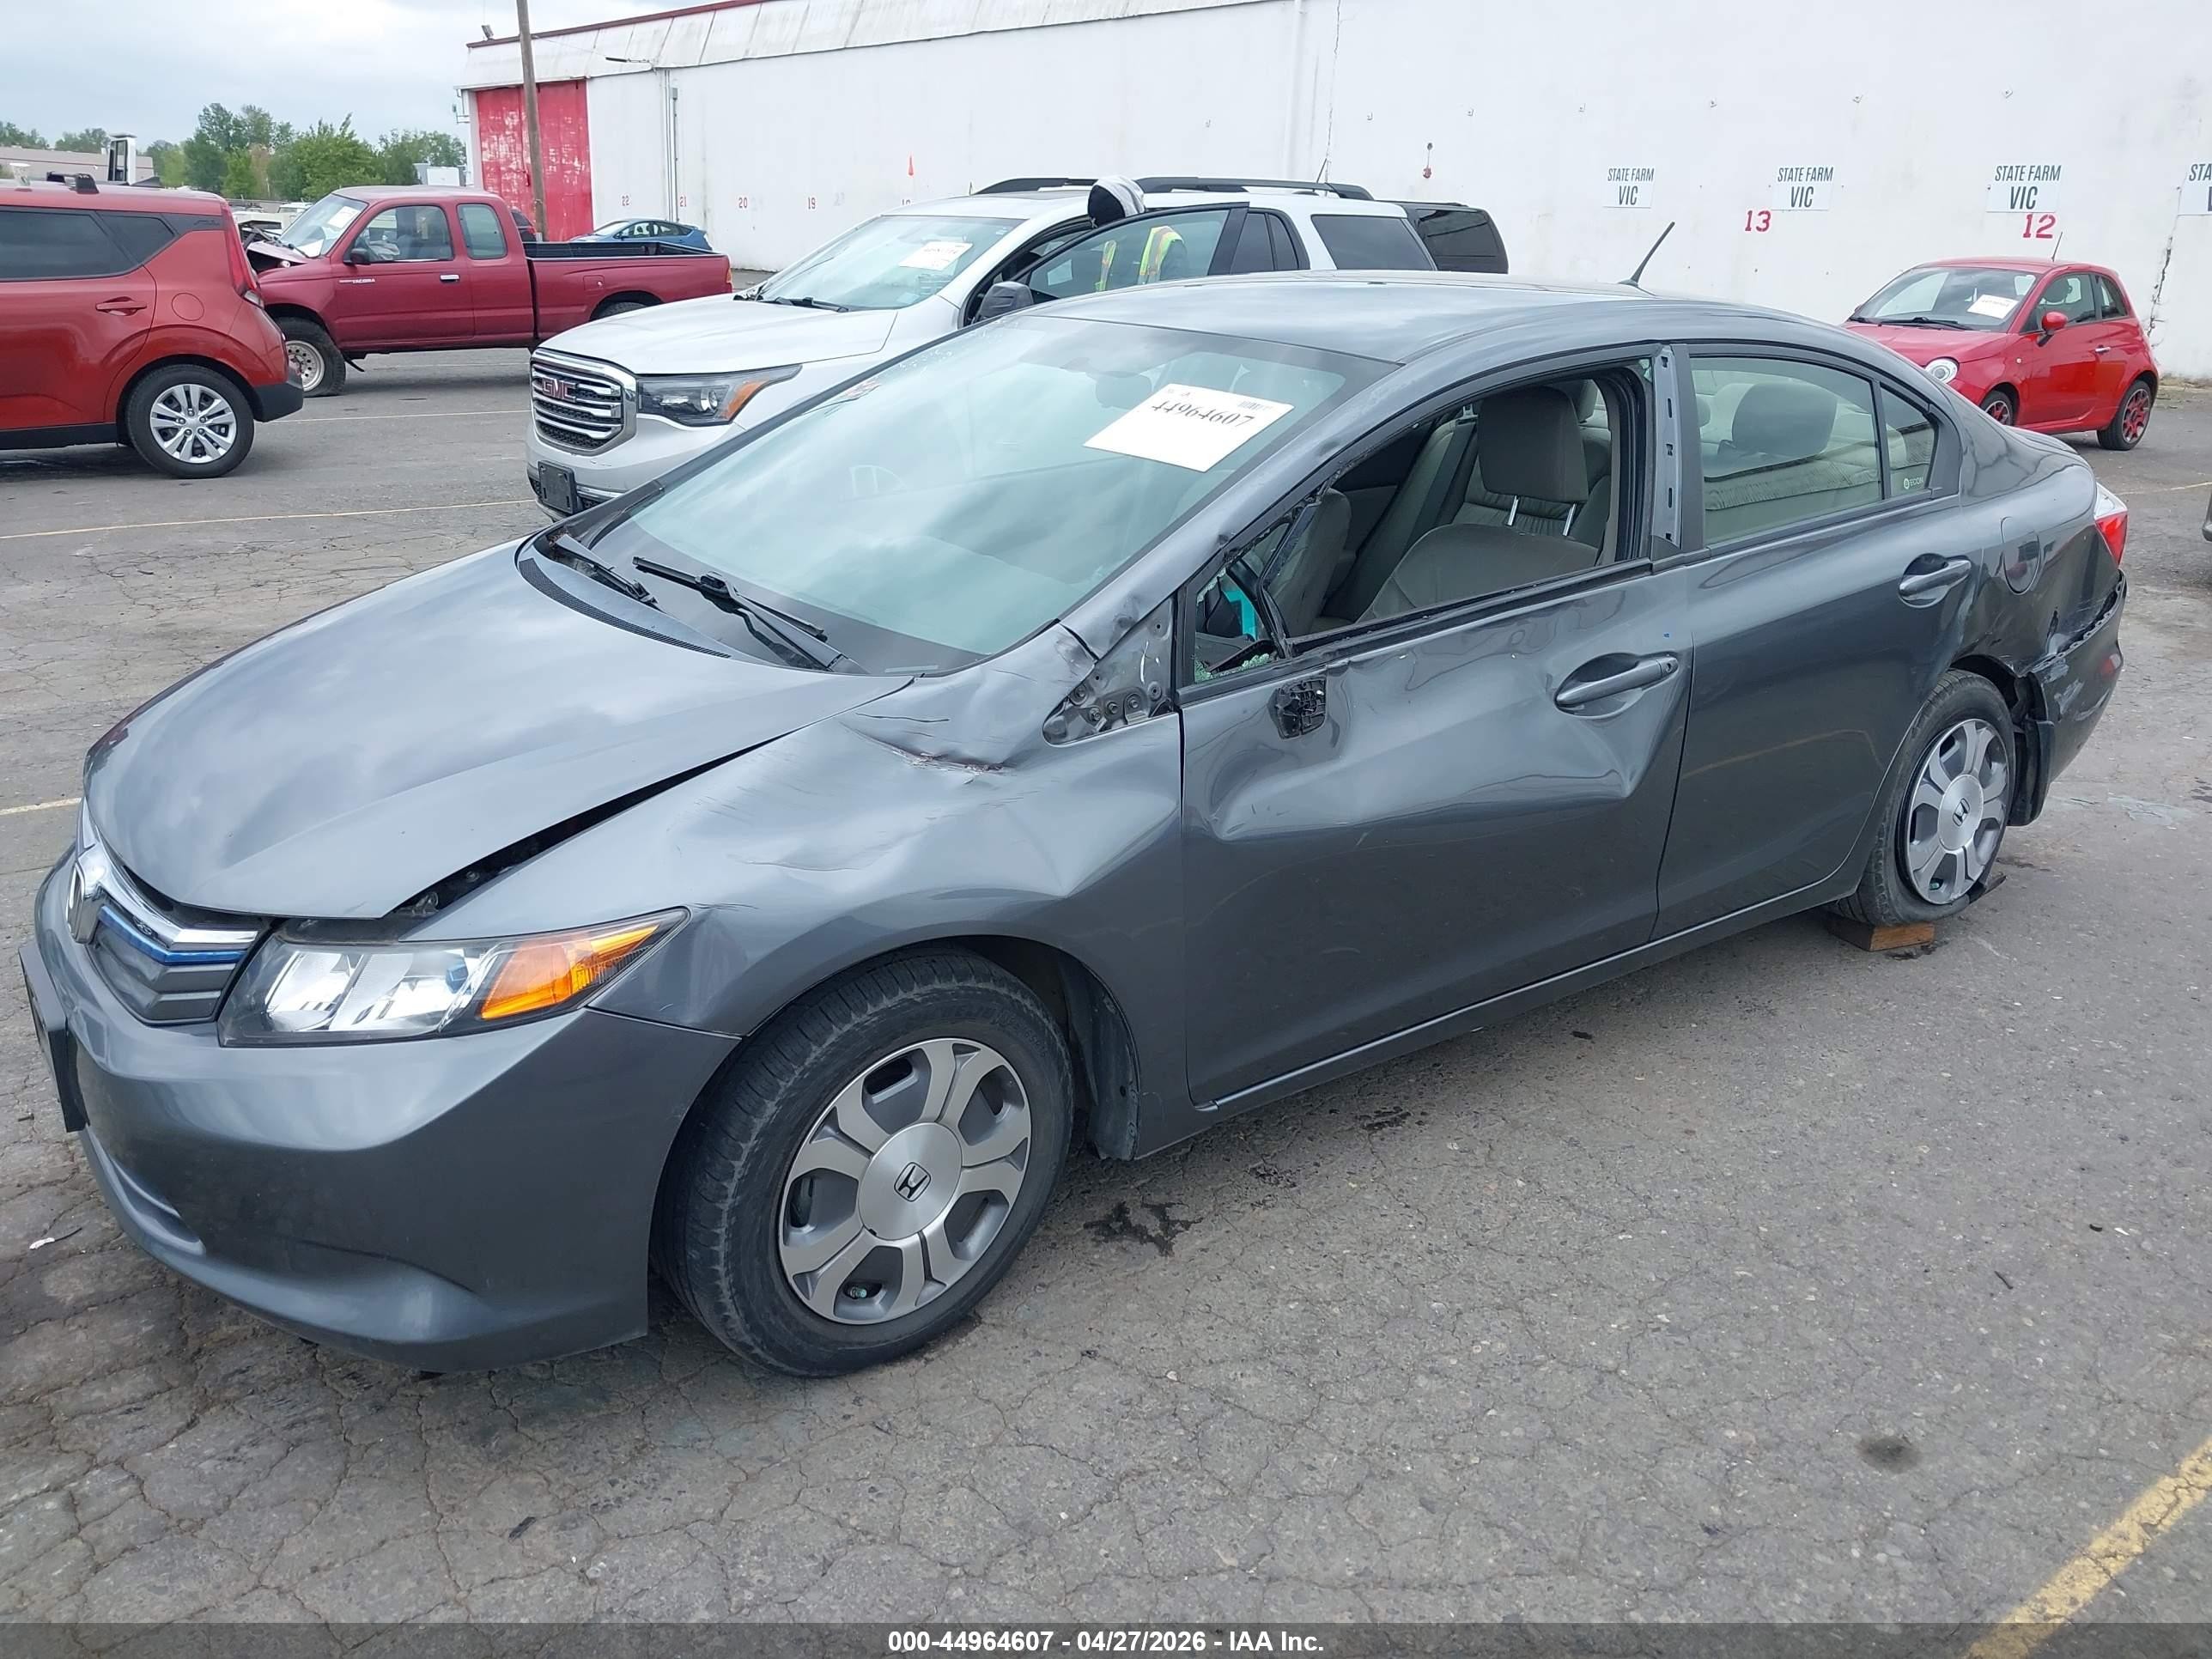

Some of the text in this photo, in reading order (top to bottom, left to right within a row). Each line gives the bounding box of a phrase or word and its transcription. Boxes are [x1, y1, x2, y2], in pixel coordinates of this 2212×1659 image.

[1607, 167, 1655, 182] STATE FARM
[1778, 167, 1833, 182] STATE FARM
[1995, 165, 2062, 181] STATE FARM
[738, 197, 748, 209] 20
[807, 197, 816, 210] 19
[1619, 185, 1638, 205] VIC
[1790, 185, 1814, 208] VIC
[2009, 185, 2039, 210] VIC
[1744, 210, 1771, 233] 13
[2022, 213, 2057, 239] 12
[542, 378, 576, 403] GMC
[1151, 400, 1255, 427] 44964607
